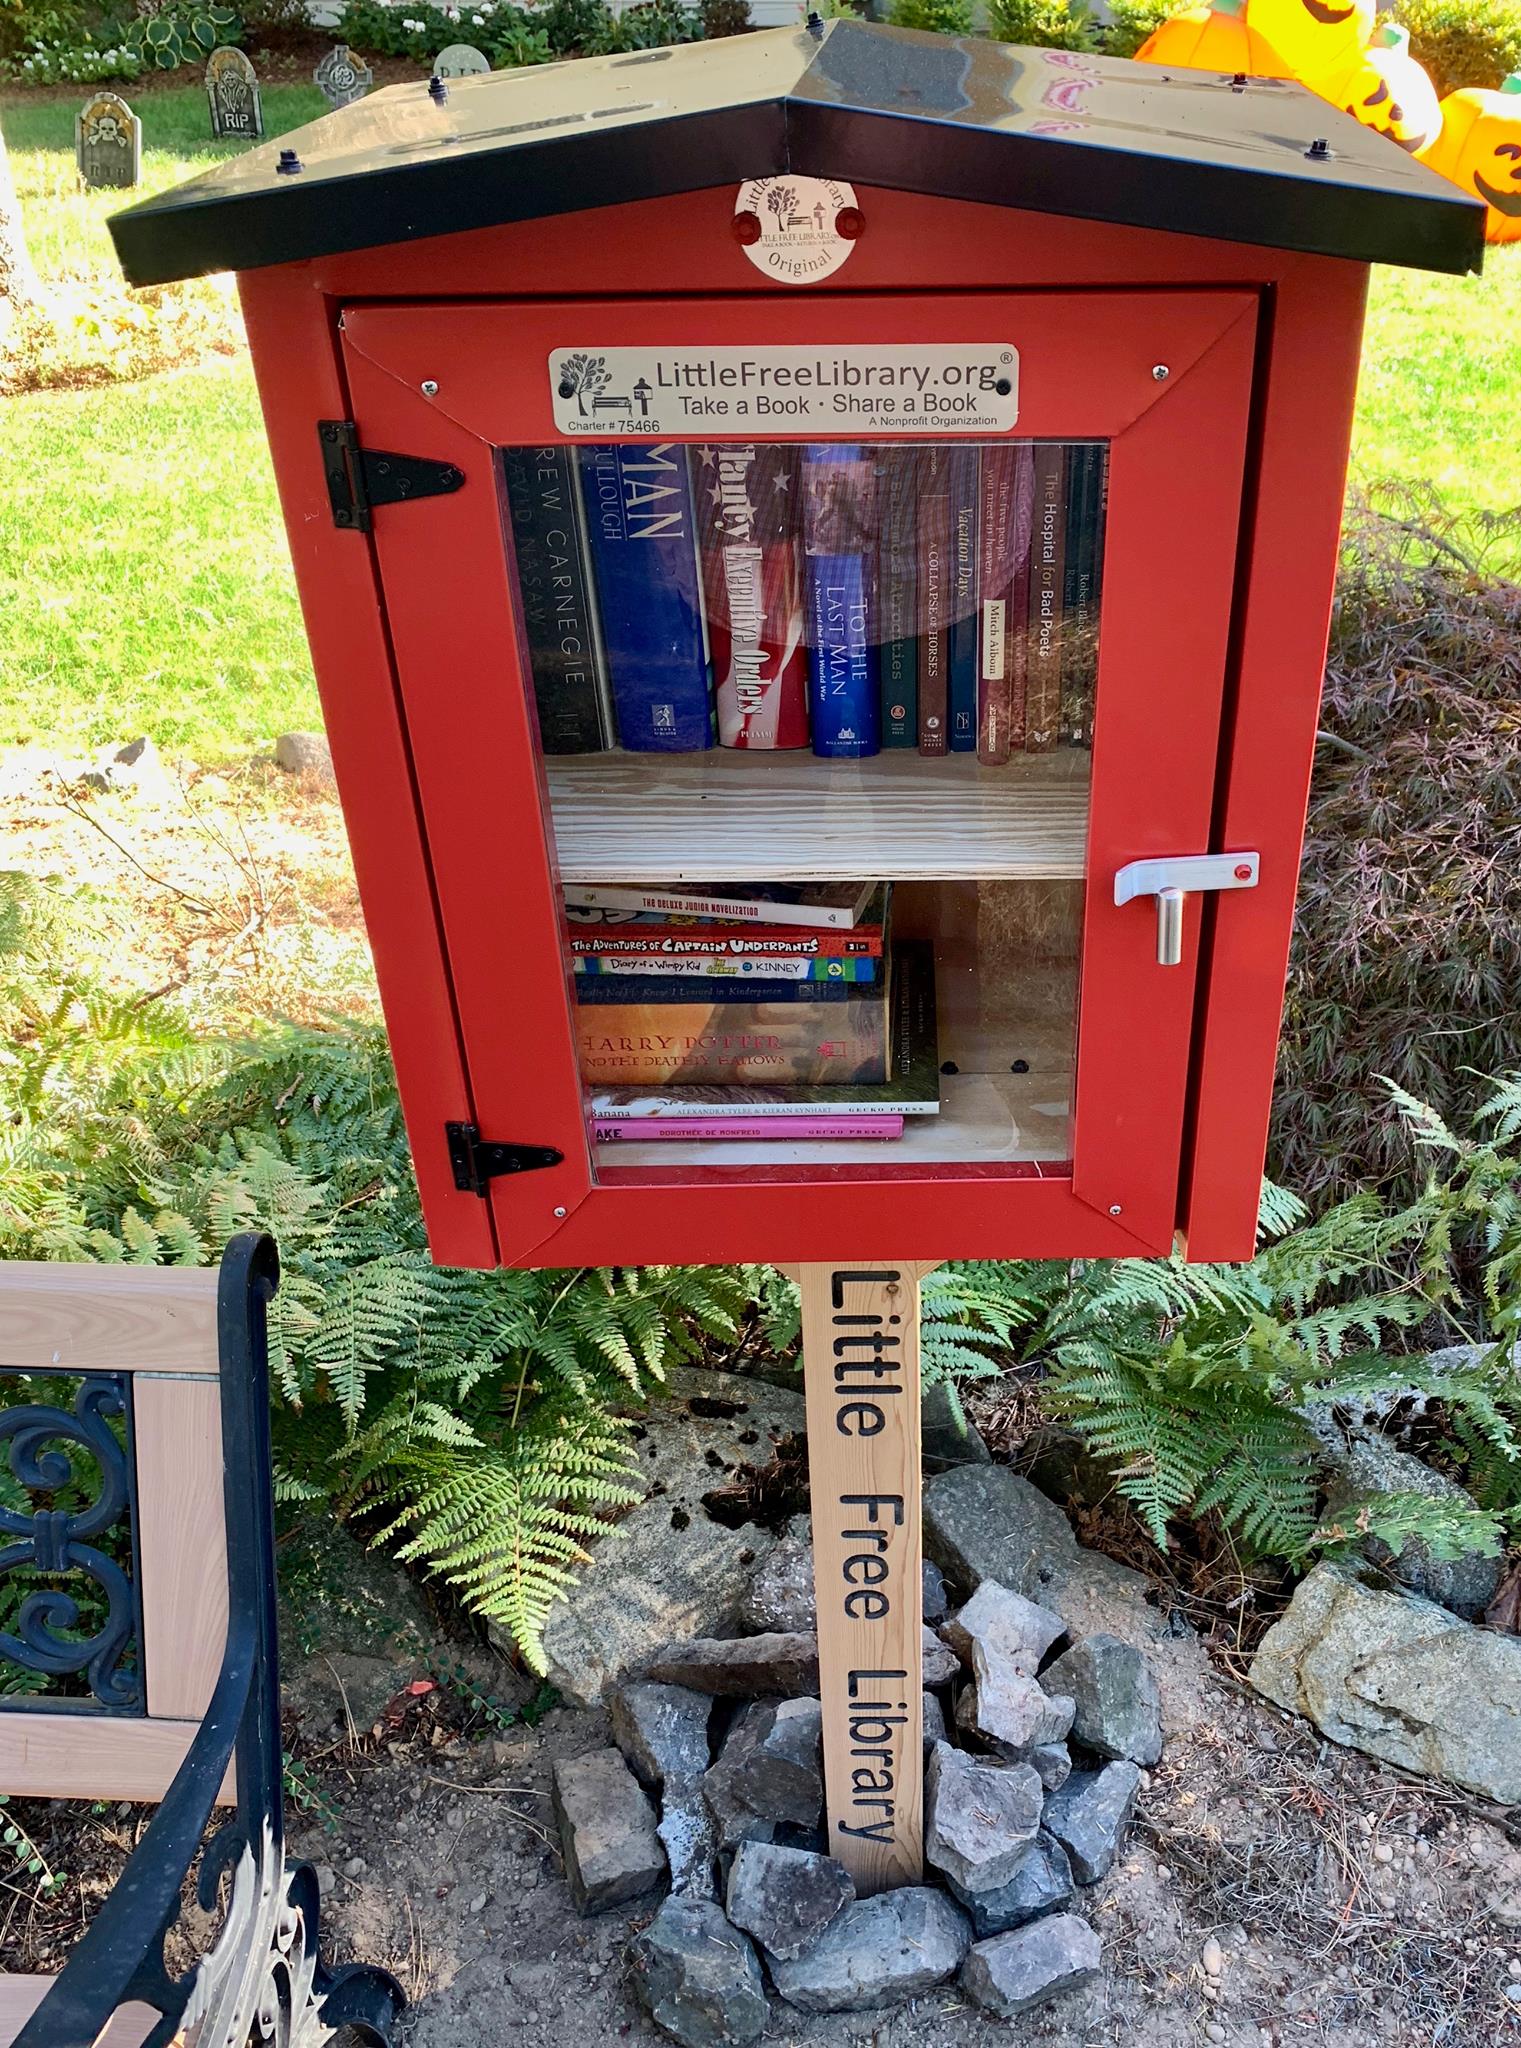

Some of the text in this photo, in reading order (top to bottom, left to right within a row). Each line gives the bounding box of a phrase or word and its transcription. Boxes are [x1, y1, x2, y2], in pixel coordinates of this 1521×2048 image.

[224, 113, 249, 128] RIP
[90, 165, 126, 178] RIP
[768, 248, 832, 278] Original
[657, 359, 998, 391] LittleFreeLibrary.org
[678, 393, 977, 415] Take a Book Share a Book
[568, 420, 660, 433] Charter # 75466
[869, 415, 998, 427] A Nonprofit Organization
[594, 446, 622, 539] ULLOUGH
[621, 443, 685, 538] MAN
[714, 444, 756, 543] lancy
[986, 492, 995, 518] meet
[955, 506, 974, 598] Vacation Days
[984, 536, 996, 574] heaven
[995, 525, 1009, 561] people
[1039, 472, 1059, 657] The Hospital for Bad Poets
[724, 547, 768, 643] Executive
[815, 578, 821, 586] A
[928, 551, 939, 615] COLLAPSE
[546, 530, 585, 684] CARNEGIE
[816, 614, 823, 623] of
[826, 586, 849, 696] LAST MAN
[849, 597, 868, 681] TO THE
[928, 630, 939, 677] HORSES
[989, 604, 999, 675] Mitch Albom
[733, 649, 773, 715] Orders
[684, 901, 710, 912] JUNIOR
[572, 939, 592, 950] The
[661, 937, 727, 952] CAPTAIN
[729, 938, 819, 953] UNDERPANTS
[610, 958, 637, 969] Diary
[655, 961, 685, 972] Wimpy
[687, 960, 701, 971] Kid
[756, 962, 801, 973] KINNEY
[729, 984, 783, 997] Kindergarten
[583, 1035, 784, 1051] HARRY POTTER
[585, 1055, 786, 1067] ND THE DEATHLY HALLOWS
[591, 1110, 631, 1118] Banana
[831, 1270, 909, 1844] Little Free Library
